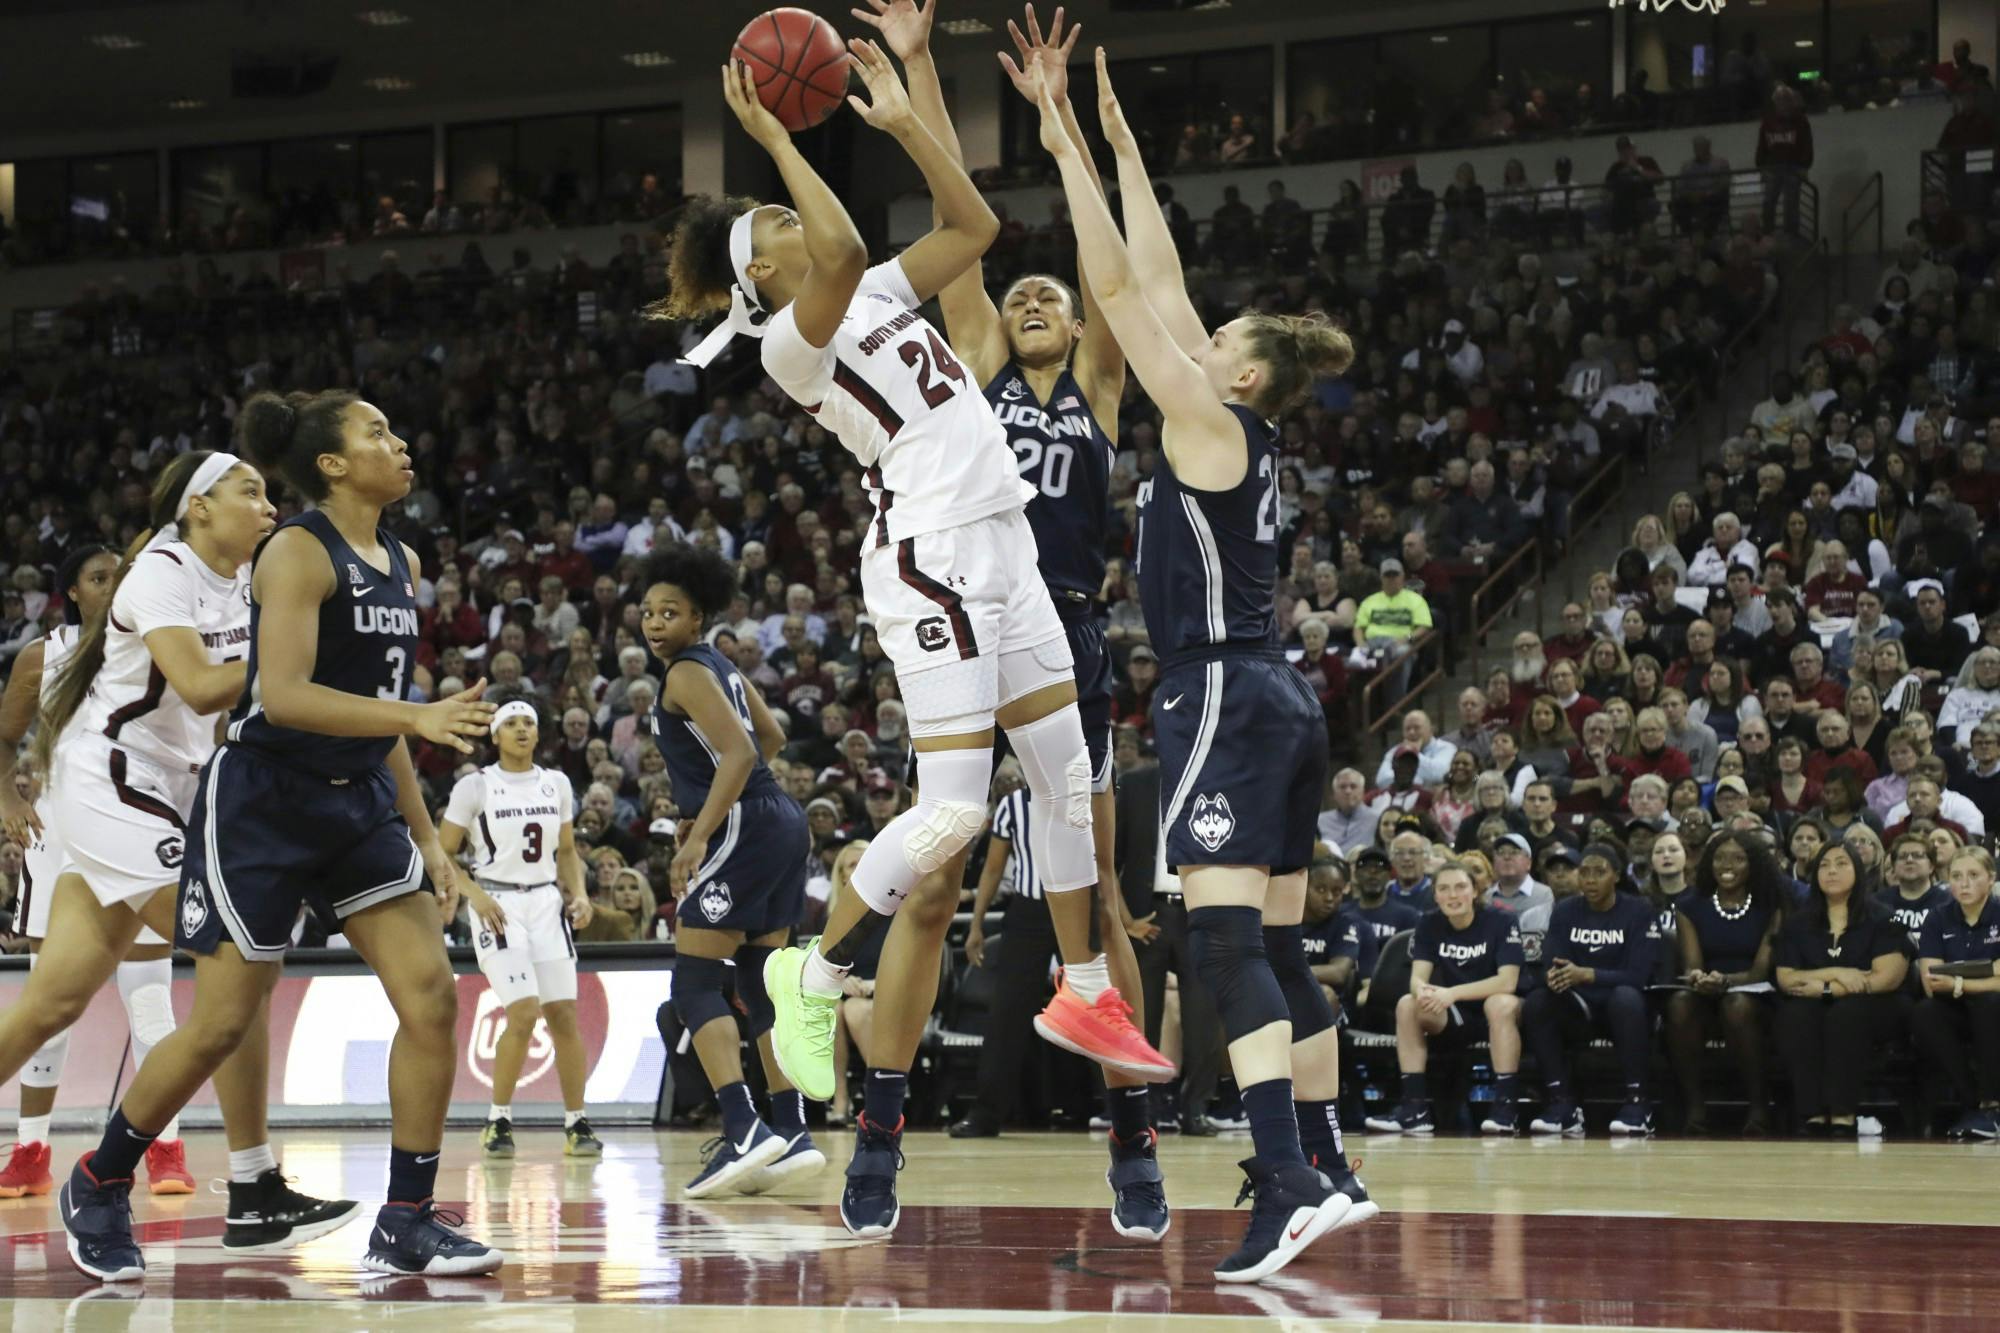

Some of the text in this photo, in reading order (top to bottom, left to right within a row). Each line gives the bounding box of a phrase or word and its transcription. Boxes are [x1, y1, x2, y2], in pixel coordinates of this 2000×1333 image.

[858, 322, 897, 356] SOUTH
[897, 328, 967, 410] 24
[993, 402, 1093, 440] UCONN
[1013, 437, 1074, 498] 20
[377, 646, 406, 700] 3
[495, 808, 522, 819] SOUTH
[522, 822, 543, 863] 3
[1439, 942, 1487, 960] UCONN
[1570, 927, 1624, 944] UCONN
